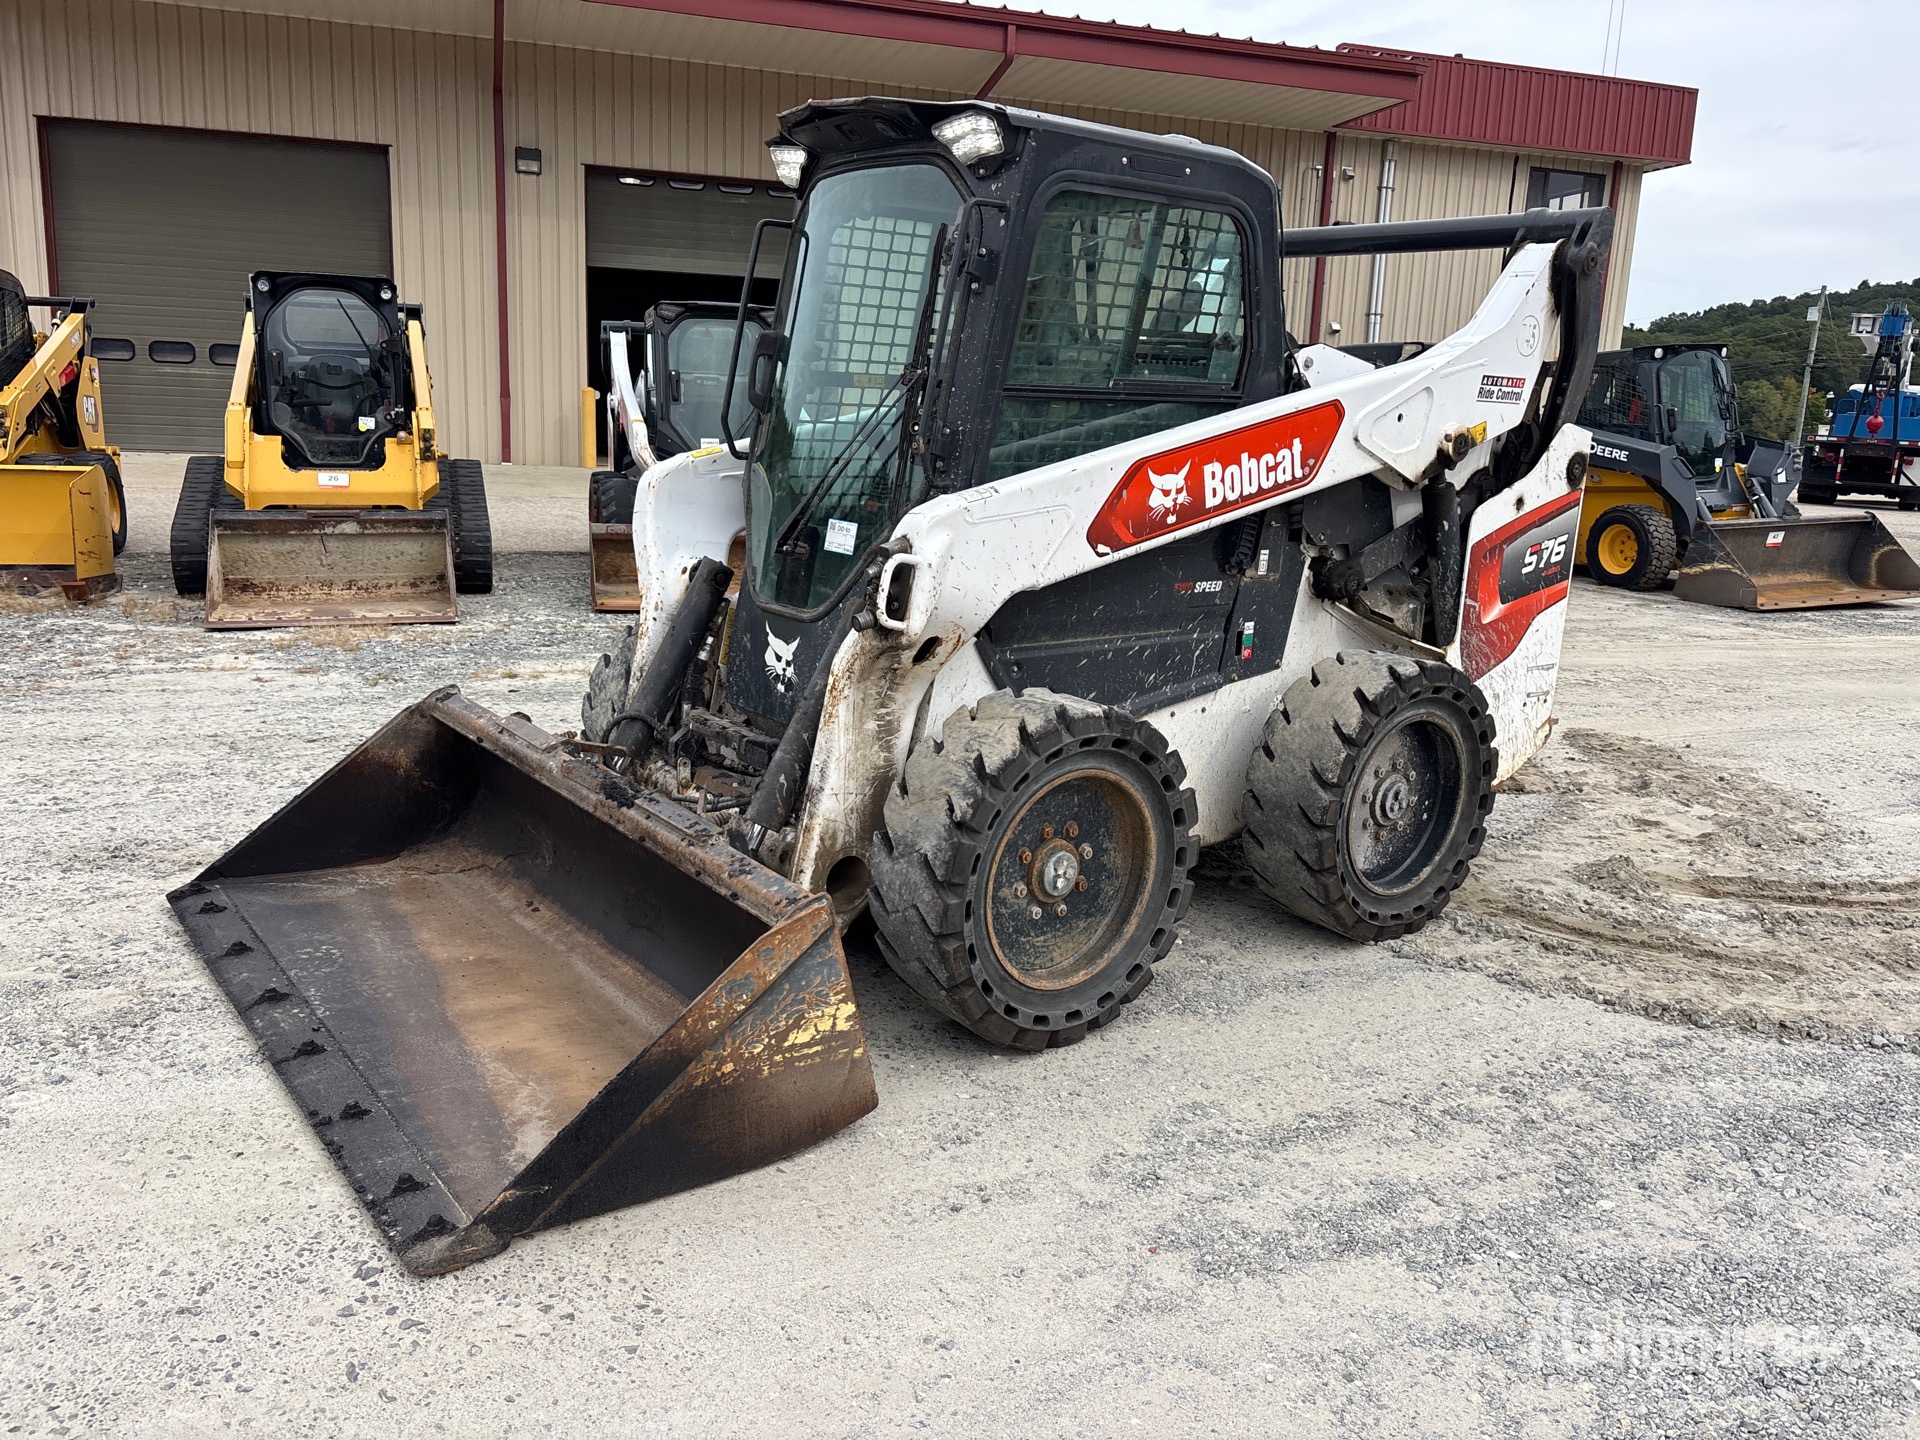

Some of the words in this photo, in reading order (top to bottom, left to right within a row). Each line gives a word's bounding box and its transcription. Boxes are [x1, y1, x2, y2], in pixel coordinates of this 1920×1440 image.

[1482, 377, 1525, 388] AUTOMATIC
[1477, 386, 1495, 400] Ride
[1496, 388, 1523, 402] Control
[1589, 441, 1629, 462] DEERE
[1203, 437, 1303, 509] Bobcat
[1521, 533, 1569, 575] S76
[1194, 580, 1223, 593] SPEED
